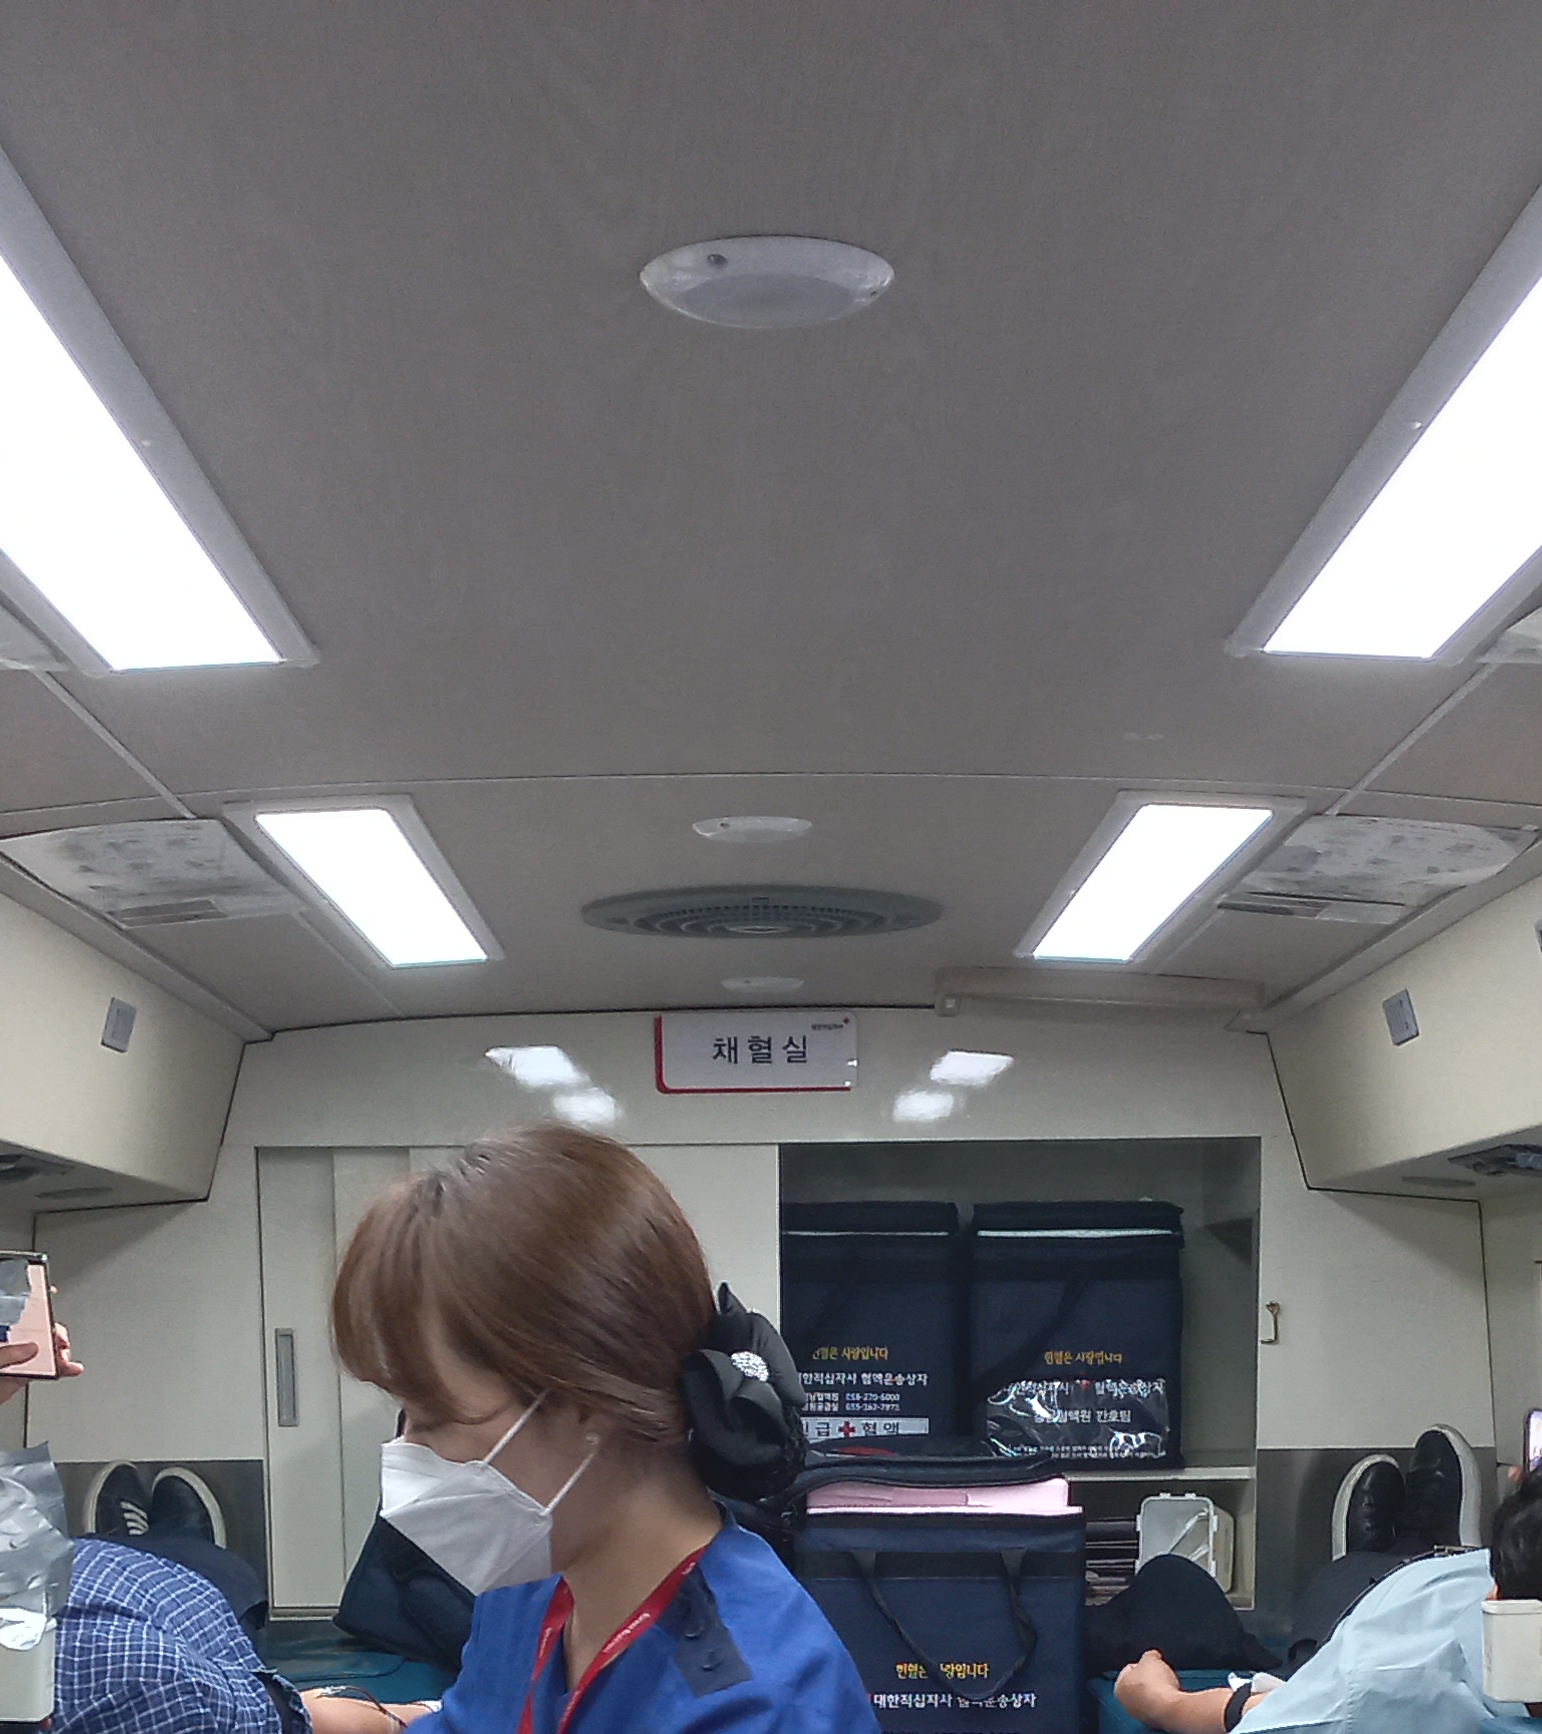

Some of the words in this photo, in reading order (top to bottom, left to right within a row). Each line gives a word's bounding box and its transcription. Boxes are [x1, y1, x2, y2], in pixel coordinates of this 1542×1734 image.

[711, 1034, 808, 1065] 채혈실
[798, 1371, 857, 1386] 한적십자사
[873, 1693, 953, 1709] 대한적십자사
